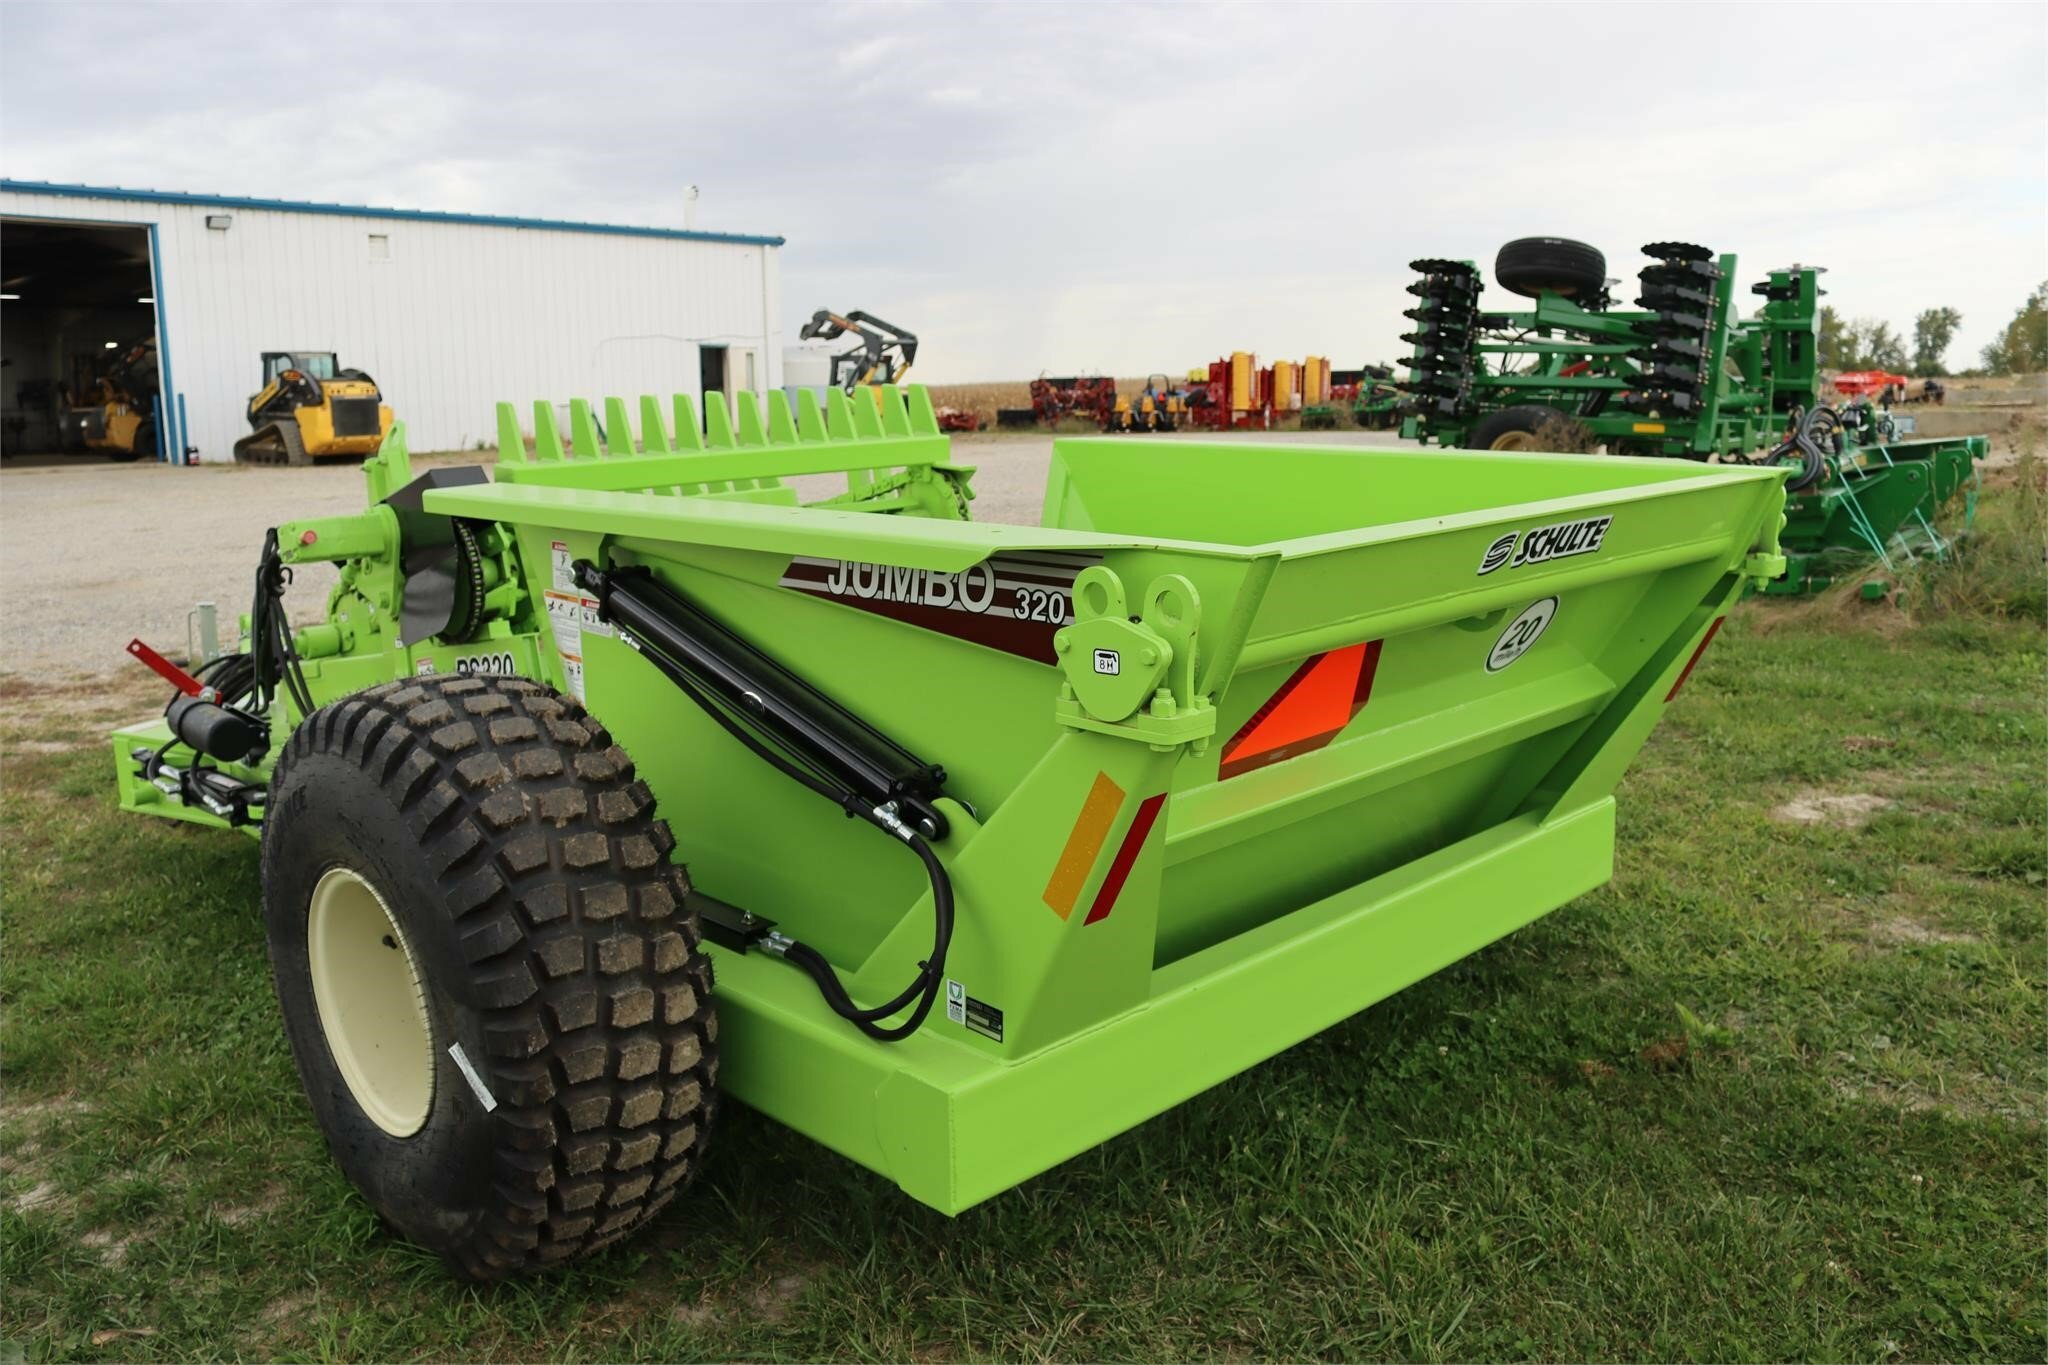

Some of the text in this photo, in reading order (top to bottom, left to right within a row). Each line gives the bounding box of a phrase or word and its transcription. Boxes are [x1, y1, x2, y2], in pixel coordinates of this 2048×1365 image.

[1513, 518, 1611, 563] SCHULTE
[827, 558, 1066, 624] JUMBO 320
[1499, 615, 1543, 651] 20
